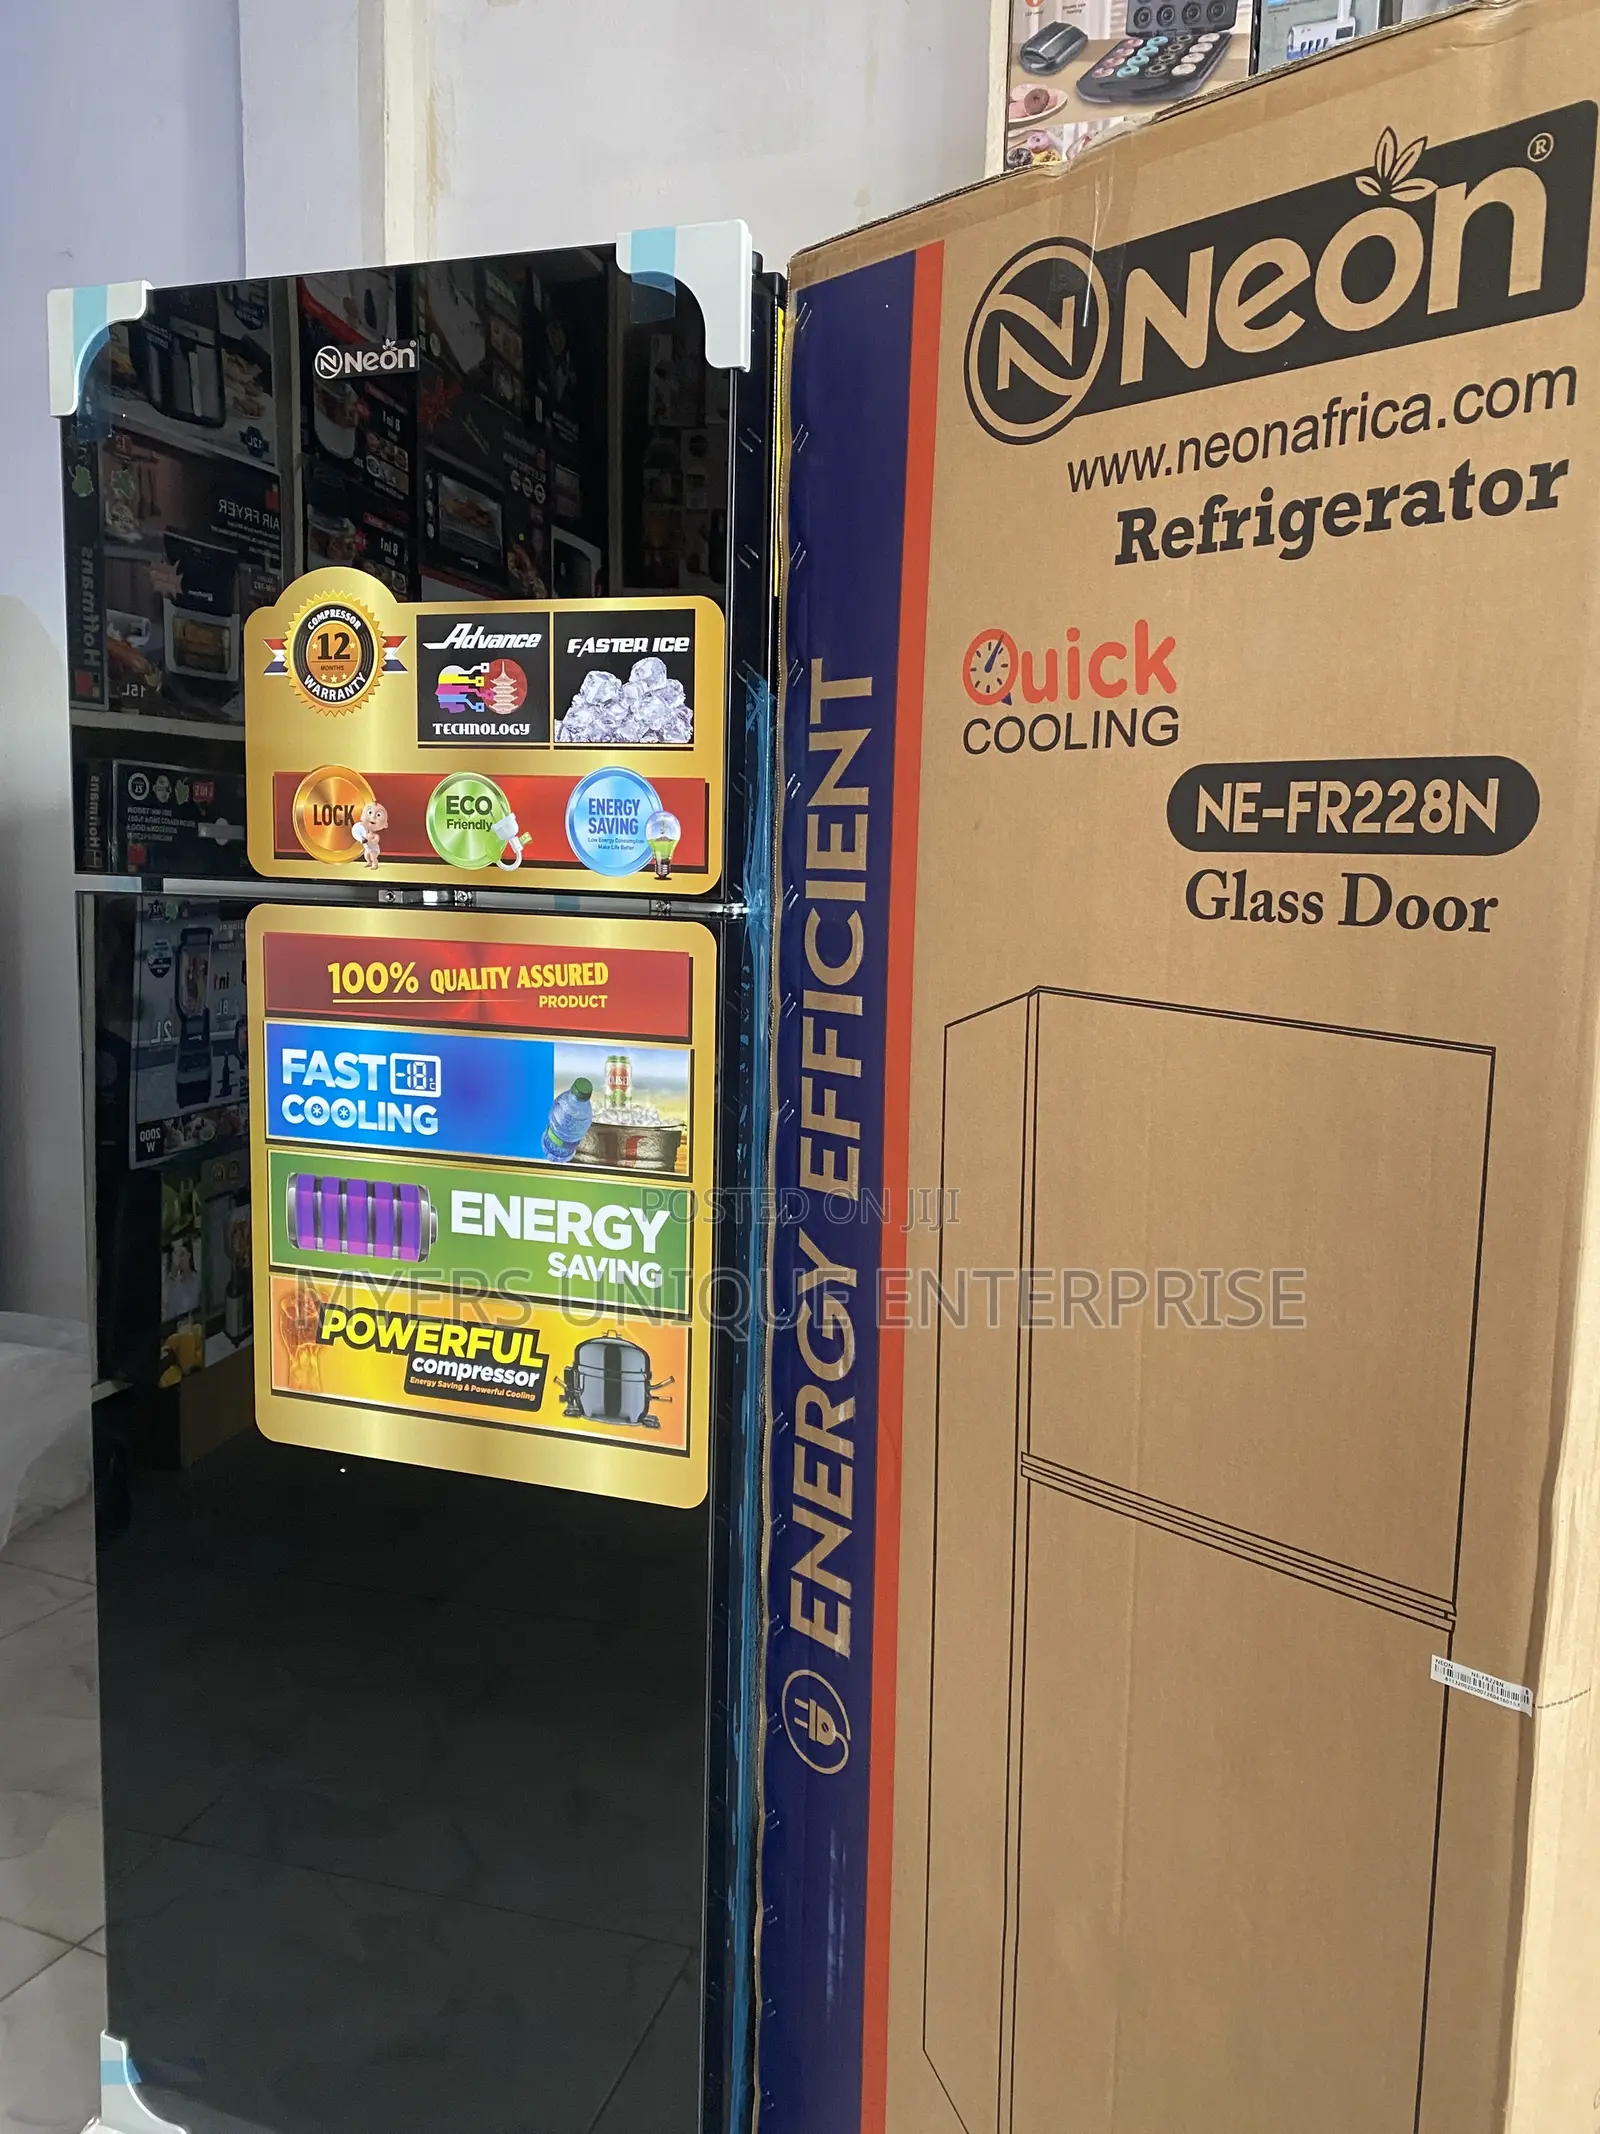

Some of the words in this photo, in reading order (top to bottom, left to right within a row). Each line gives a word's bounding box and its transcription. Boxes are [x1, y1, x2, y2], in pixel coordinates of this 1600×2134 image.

[1120, 166, 1548, 386] Neon
[345, 346, 416, 374] Neon
[1067, 365, 1578, 493] www.neonafrica.com
[1115, 458, 1570, 566] Refrigerator
[307, 608, 363, 631] COMPRESSOR
[315, 631, 352, 661] 12
[423, 622, 542, 651] Advance
[567, 636, 648, 658] FASTER
[653, 635, 690, 654] ICE
[320, 664, 345, 672] MONTHS
[962, 619, 1177, 705] Quick
[302, 672, 368, 701] WARRANTY
[433, 722, 531, 737] TECHNOLOGY
[962, 705, 1180, 755] COOLING
[313, 803, 355, 828] LOCK
[445, 795, 494, 816] ECO
[588, 797, 640, 815] ENERGY
[1196, 778, 1499, 835] NE-FR228N
[446, 818, 494, 833] Friendly
[588, 817, 638, 835] SAVING
[598, 837, 614, 845] Energy
[1185, 869, 1324, 924] Glass
[1338, 872, 1499, 933] Door
[799, 657, 873, 1201] EFFICIENT
[327, 961, 420, 995] 100%
[430, 966, 511, 994] QUALITY
[516, 962, 609, 988] ASSURED
[538, 994, 608, 1009] PRODUCT
[281, 1048, 386, 1091] FAST
[281, 1094, 439, 1136] COOLING
[450, 1190, 672, 1254] ENERGY
[547, 1252, 663, 1289] SAVING
[320, 1308, 546, 1368] POWERFUL
[411, 1356, 541, 1389] compressor
[409, 1376, 437, 1388] Energy
[437, 1380, 463, 1392] Saving
[463, 1384, 470, 1392] &
[470, 1384, 505, 1397] Powerful
[505, 1390, 536, 1402] Cooling
[788, 1227, 858, 1660] ENERGY
[1435, 1658, 1453, 1669] NEON
